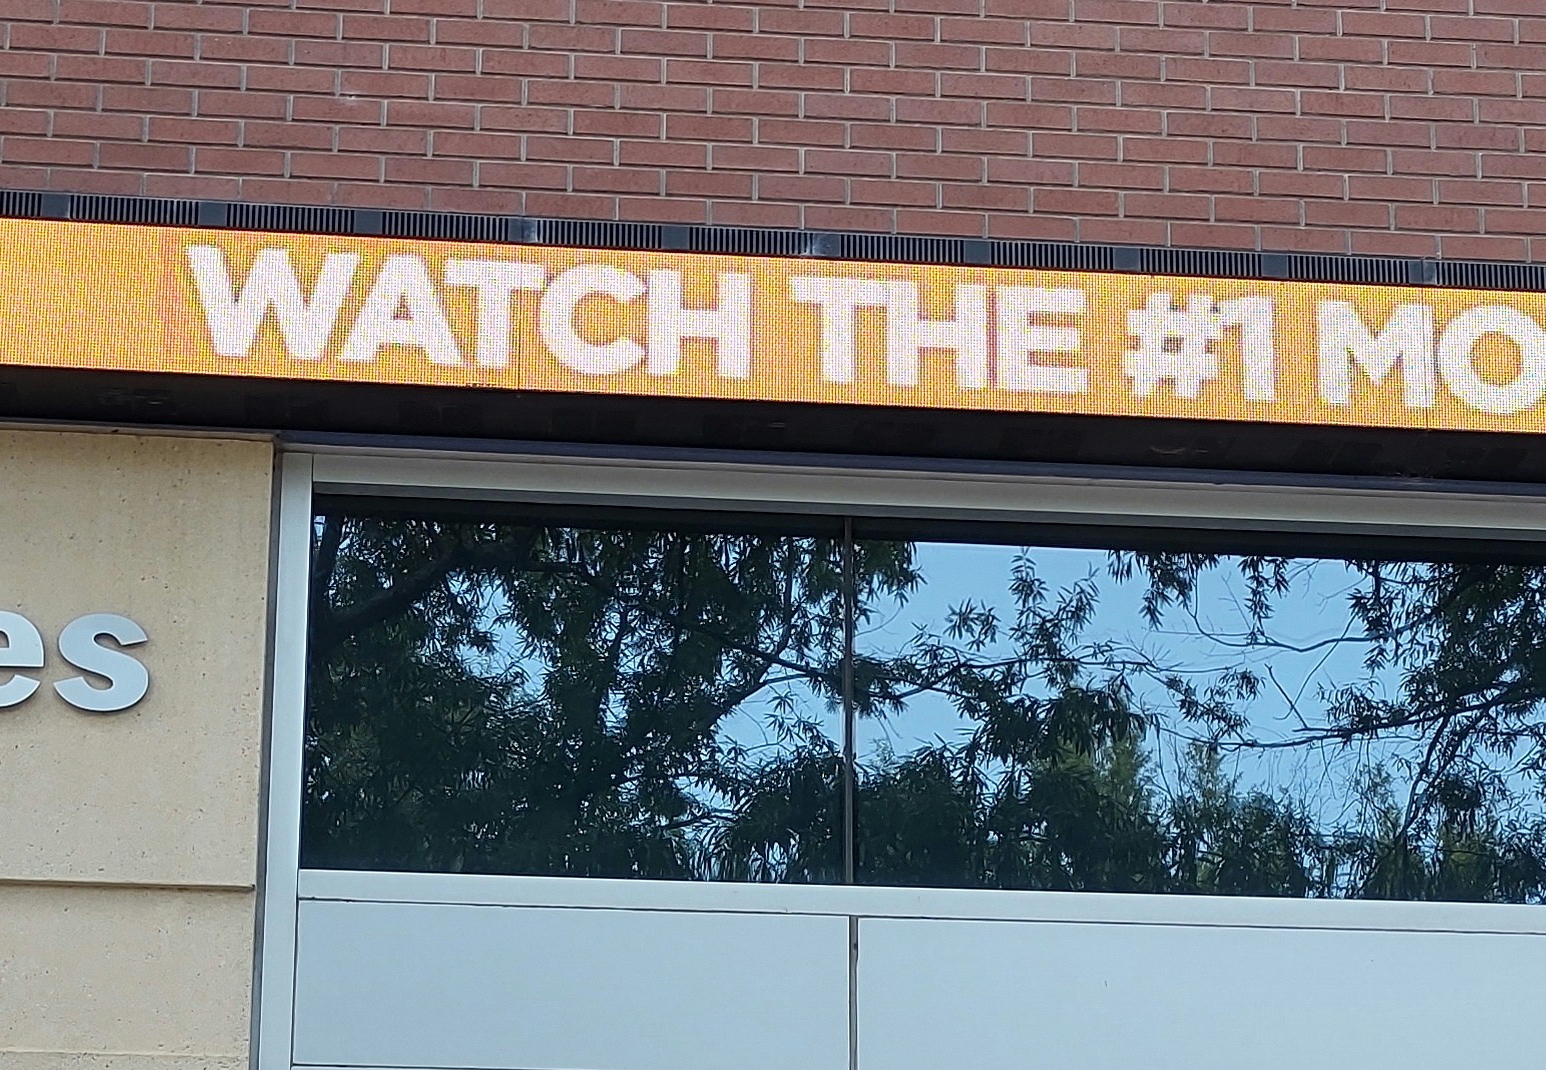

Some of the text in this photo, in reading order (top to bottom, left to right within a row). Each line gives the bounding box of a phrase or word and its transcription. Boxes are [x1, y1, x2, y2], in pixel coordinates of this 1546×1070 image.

[186, 243, 751, 379] WATCH
[791, 275, 1089, 395] THE
[1122, 293, 1277, 404] #1
